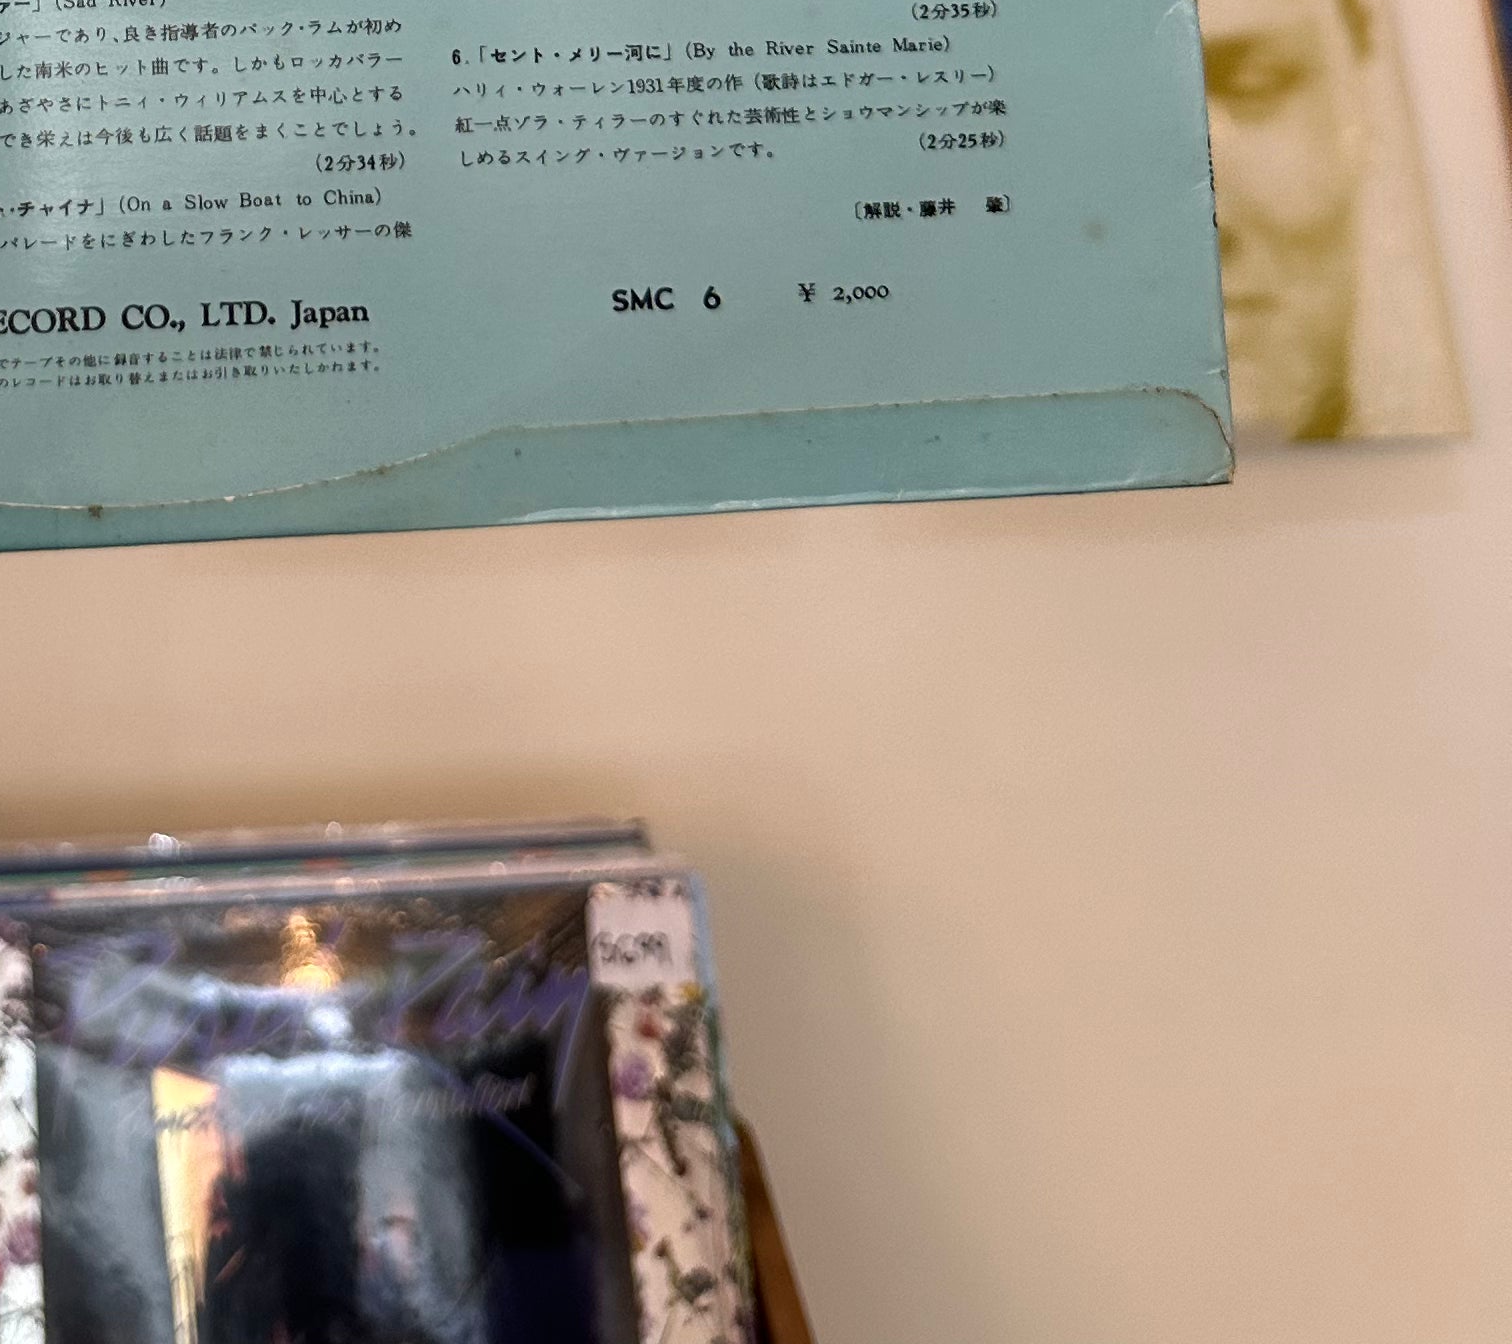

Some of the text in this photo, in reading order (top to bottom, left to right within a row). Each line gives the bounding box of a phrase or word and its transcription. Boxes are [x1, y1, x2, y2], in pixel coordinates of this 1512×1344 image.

[120, 195, 151, 214] (On
[163, 200, 172, 211] a
[185, 194, 228, 210] Slow
[240, 192, 281, 208] Boat
[296, 194, 312, 206] to
[324, 187, 381, 206] China)
[612, 283, 891, 313] SMC 6 ¥ 2,000
[121, 304, 185, 333] CO.,
[200, 301, 276, 327] LTD.
[291, 300, 369, 330] Japan
